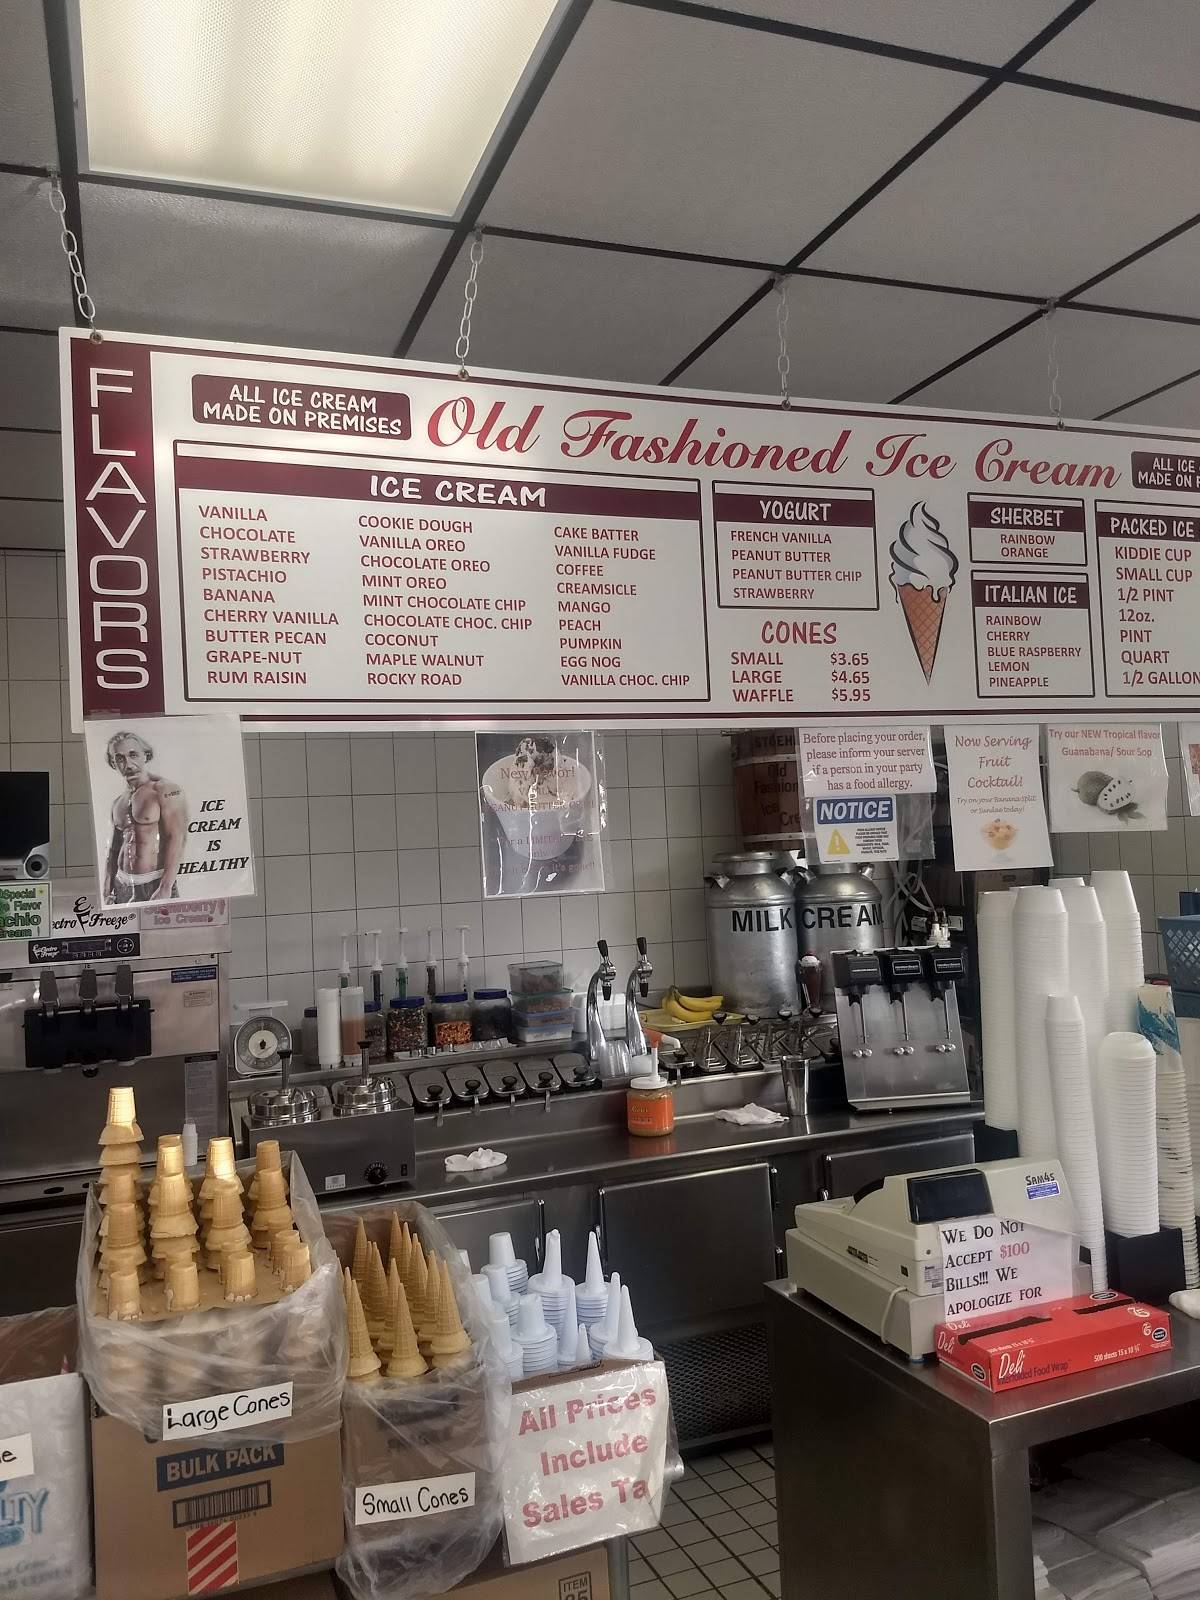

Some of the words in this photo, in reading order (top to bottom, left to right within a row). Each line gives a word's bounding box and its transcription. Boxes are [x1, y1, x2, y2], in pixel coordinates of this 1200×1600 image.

[229, 384, 265, 404] ALL
[273, 387, 302, 406] ICE
[311, 390, 377, 414] CREAM
[203, 402, 261, 424] MADE
[269, 408, 296, 426] ON
[305, 410, 401, 435] PREMISES
[427, 396, 545, 454] Old
[560, 409, 852, 474] Fashioned
[865, 433, 957, 479] Ice
[975, 438, 1122, 489] Cream
[370, 475, 422, 500] ICE
[436, 481, 546, 508] CREAM
[199, 505, 267, 522] VANILLA
[759, 500, 831, 521] YOGURT
[990, 507, 1064, 527] SHERBET
[85, 367, 150, 690] FLAVORS
[359, 515, 414, 531] COOKIE
[419, 518, 473, 534] DOUGH
[1110, 517, 1167, 536] PACKED
[1173, 520, 1194, 538] ICE
[200, 526, 295, 543] CHOCOLATE
[554, 526, 587, 539] CAKE
[592, 528, 639, 542] BATTER
[731, 531, 778, 543] FRENCH
[782, 533, 832, 545] VANILLA
[201, 547, 310, 564] STRAWBERRY
[1115, 546, 1161, 561] KIDDIE
[1165, 548, 1191, 562] CUP
[202, 567, 286, 583] PISTACHIO
[556, 564, 604, 577] COFFEE
[733, 569, 782, 580] PEANUT
[785, 570, 832, 582] BUTTER
[835, 570, 862, 582] CHIP
[203, 588, 274, 603] BANANA
[557, 582, 637, 596] CREAMSICLE
[733, 588, 814, 600] STRAWBERRY
[985, 585, 1047, 603] ITALIAN
[1053, 587, 1077, 604] ICE
[1118, 587, 1138, 603] 1/2
[1143, 589, 1174, 602] PINT
[363, 594, 403, 608] MINT
[407, 596, 491, 610] CHOCOLATE
[495, 598, 526, 611] CHIP
[558, 601, 611, 614] MANGO
[204, 608, 267, 624] CHERRY
[273, 610, 339, 625] VANILLA
[364, 614, 450, 628] CHOCOLATE
[454, 616, 497, 630] CHOC.
[501, 618, 532, 630] CHIP
[986, 616, 1042, 626] RAINBOW
[1119, 609, 1154, 622] 12oz.
[559, 619, 601, 631] PEACH
[205, 630, 269, 645] BUTTER
[275, 631, 326, 645] PECAN
[365, 633, 438, 647] COCONUT
[761, 621, 837, 645] CONES
[987, 631, 1030, 641] CHERRY
[1120, 629, 1152, 642] PINT
[560, 638, 622, 650] PUMPKIN
[206, 650, 302, 664] GRAPE-NUT
[731, 651, 784, 665] SMALL
[830, 652, 869, 666] $3.65
[988, 647, 1015, 657] BLUE
[1019, 647, 1081, 657] RASPBERRY
[1121, 650, 1169, 665] QUART
[366, 653, 417, 666] MAPLE
[422, 654, 484, 667] WALNUT
[561, 656, 587, 668] EGG
[591, 656, 621, 668] NOG
[989, 662, 1029, 671] LEMON
[208, 670, 248, 684] RUM
[253, 671, 306, 684] RAISIN
[367, 672, 416, 686] ROCKY
[421, 673, 462, 686] ROAD
[562, 674, 615, 686] VANILLA
[619, 674, 658, 687] CHOC.
[662, 674, 690, 686] CHIP
[732, 670, 782, 684] LARGE
[831, 671, 870, 684] $4.65
[990, 677, 1048, 687] PINEAPPLE
[732, 689, 794, 702] WAFFLE
[831, 688, 871, 702] $5.95
[803, 733, 836, 743] Before
[838, 733, 873, 748] placing
[875, 733, 896, 747] your
[898, 731, 926, 743] order,
[1049, 729, 1063, 739] Try
[1081, 730, 1101, 739] NEW
[1104, 730, 1136, 740] Tropical
[955, 735, 980, 747] Now
[984, 735, 1032, 750] Serving
[806, 748, 837, 762] please
[839, 747, 871, 758] inform
[874, 749, 896, 762] your
[897, 748, 925, 757] server
[1116, 748, 1134, 756] Sour
[1137, 747, 1152, 757] Sop
[979, 755, 1012, 769] Fruit
[500, 768, 528, 780] New
[812, 764, 821, 775] if
[822, 767, 828, 775] a
[830, 767, 862, 778] person
[864, 764, 874, 774] in
[876, 766, 897, 778] your
[900, 763, 923, 776] party
[828, 780, 845, 791] has
[854, 779, 875, 790] food
[877, 778, 913, 791] allergy.
[968, 774, 1023, 788] Cocktail!
[200, 800, 225, 813] ICE
[820, 801, 891, 820] NOTICE
[188, 818, 241, 833] CREAM
[207, 840, 221, 851] IS
[177, 857, 249, 875] HEALTHY
[732, 907, 793, 933] MILK
[801, 903, 884, 929] CREAM
[1000, 1241, 1030, 1259] $100
[938, 1331, 955, 1354] Deli
[999, 1350, 1025, 1379] Deli
[1033, 1363, 1050, 1377] Food
[167, 1402, 229, 1430] Large
[234, 1391, 291, 1417] Cones
[519, 1405, 556, 1436] All
[567, 1386, 656, 1424] Prices
[540, 1433, 648, 1476] Include
[167, 1453, 220, 1482] BULK
[225, 1444, 276, 1469] PACK
[362, 1494, 411, 1516] Small
[418, 1486, 469, 1512] Cones
[523, 1489, 603, 1528] Sales
[564, 1577, 587, 1592] ITEM
